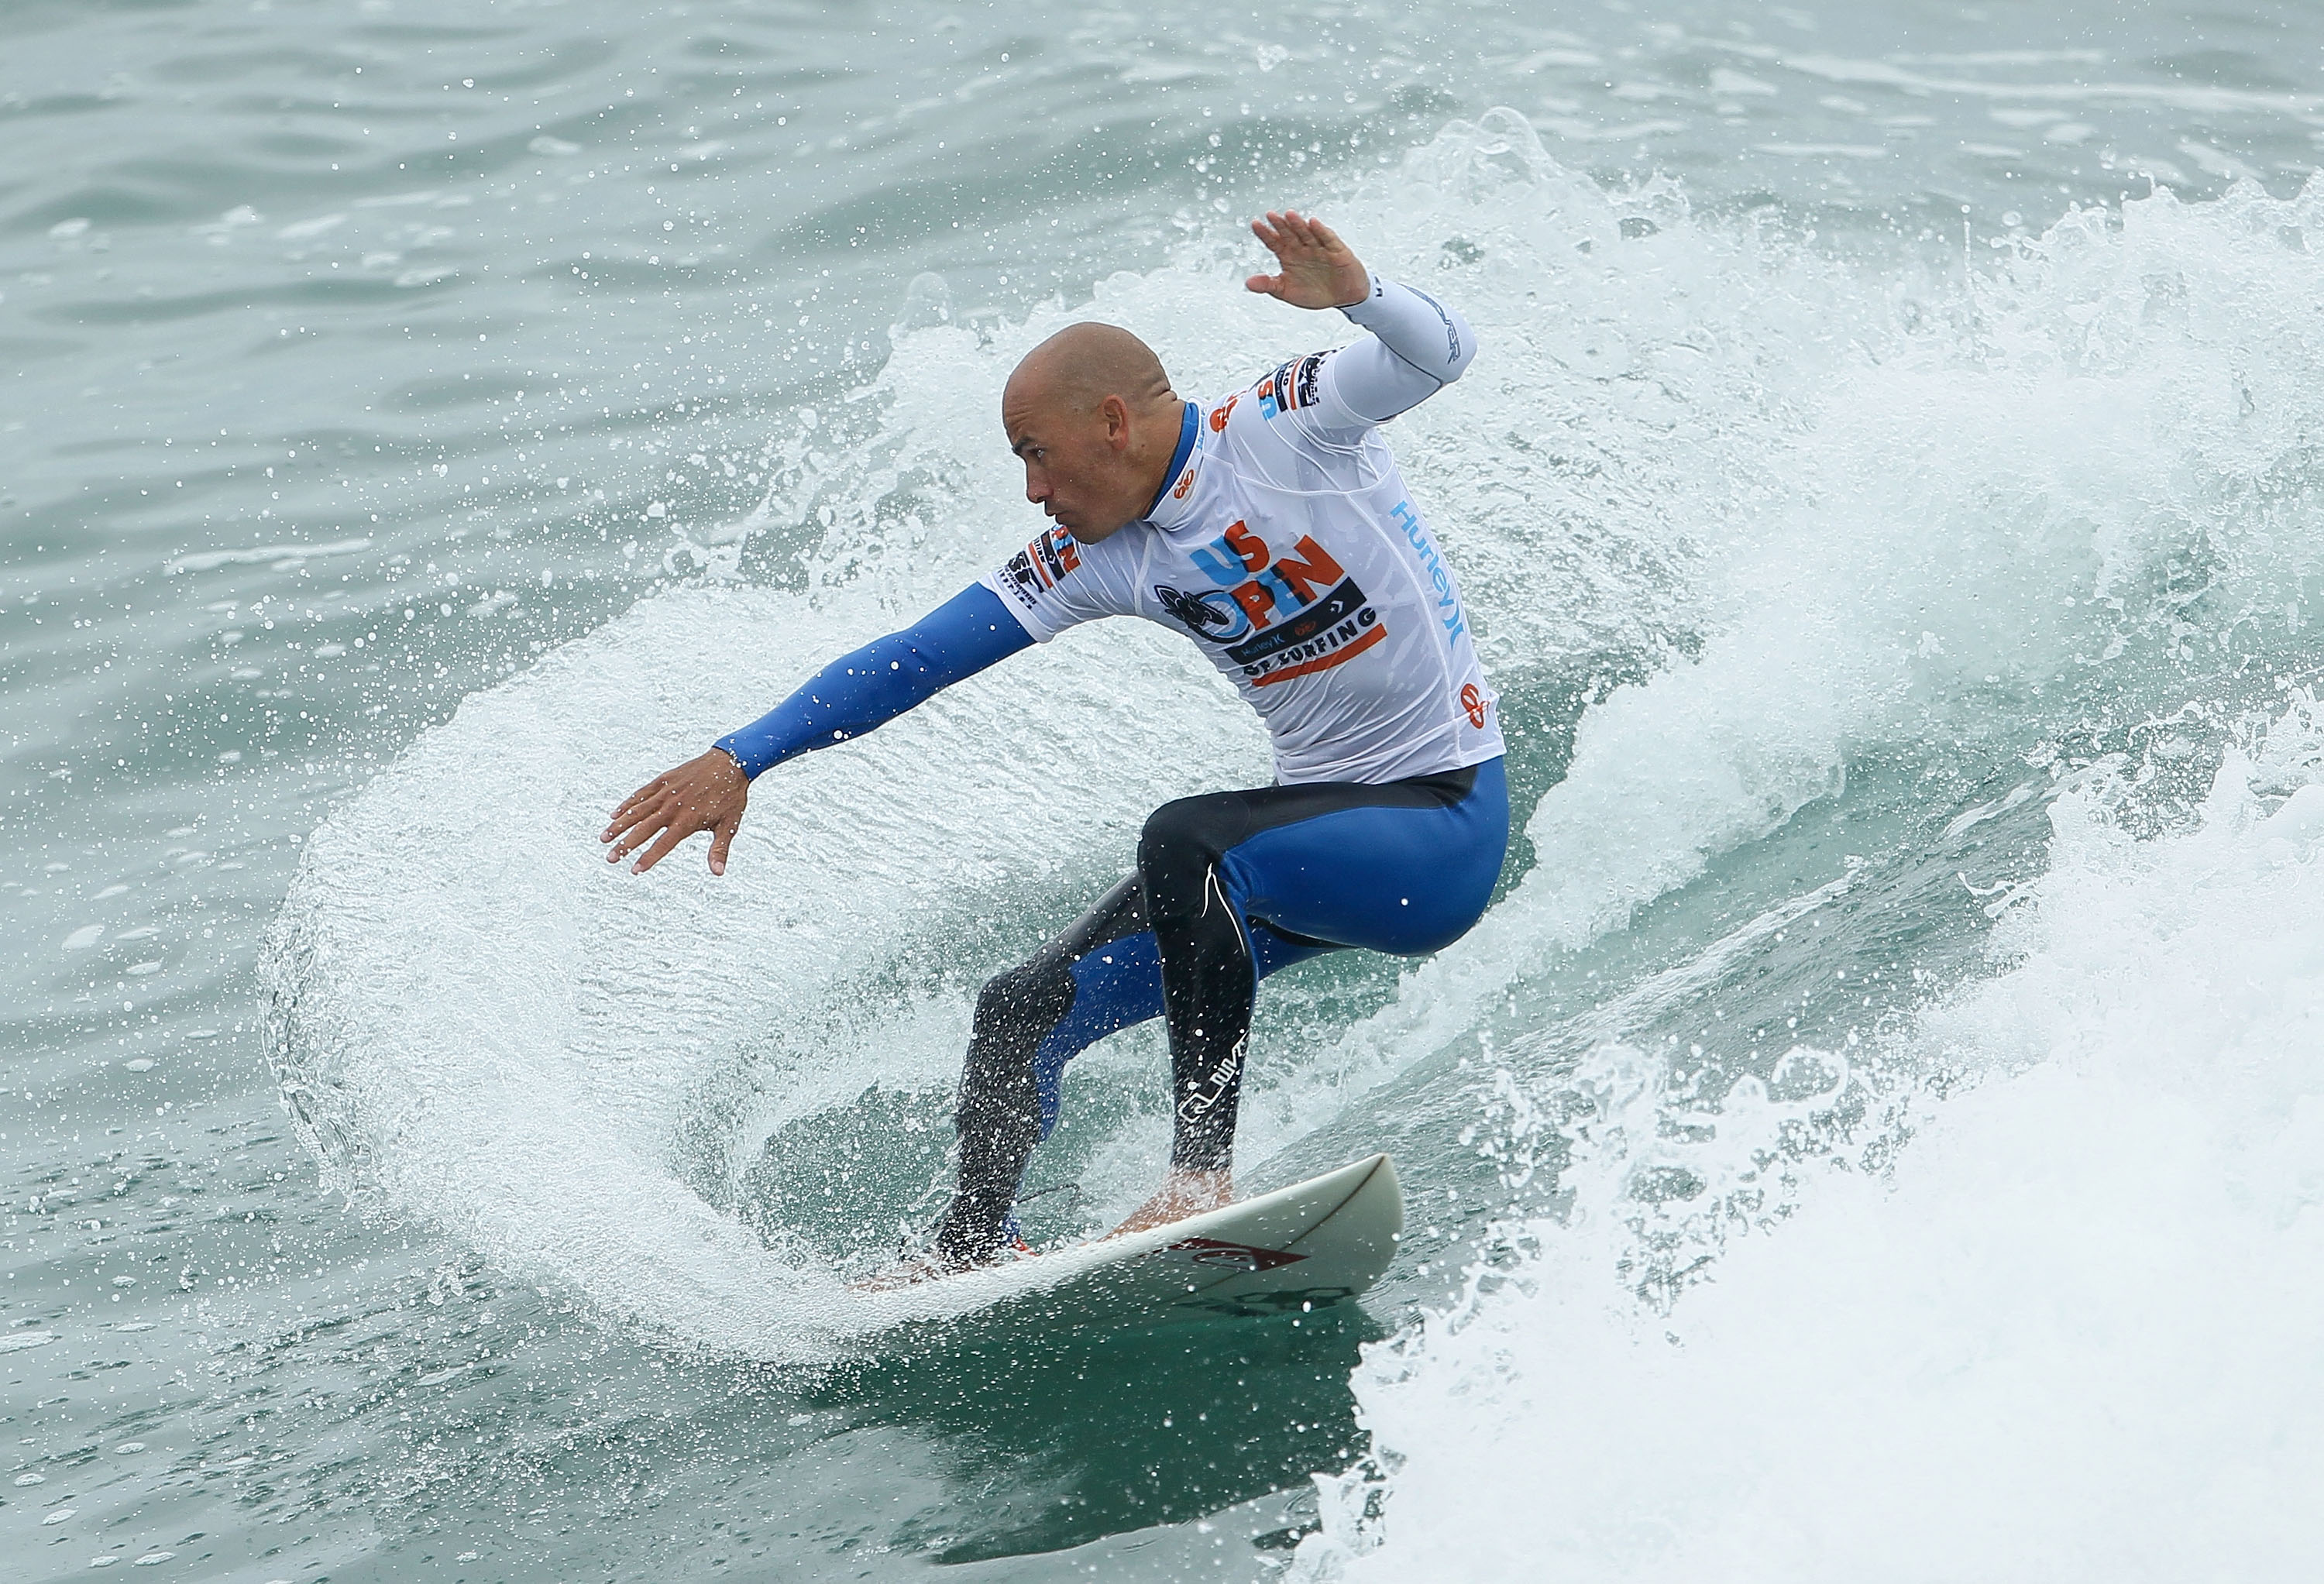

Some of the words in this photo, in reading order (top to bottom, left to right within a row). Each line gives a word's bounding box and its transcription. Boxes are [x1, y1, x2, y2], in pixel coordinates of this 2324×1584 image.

[1257, 380, 1277, 421] US
[1190, 520, 1270, 586] US
[1390, 500, 1454, 607] Hurley
[1194, 534, 1345, 643] OPEN
[1278, 607, 1377, 666] SURFING
